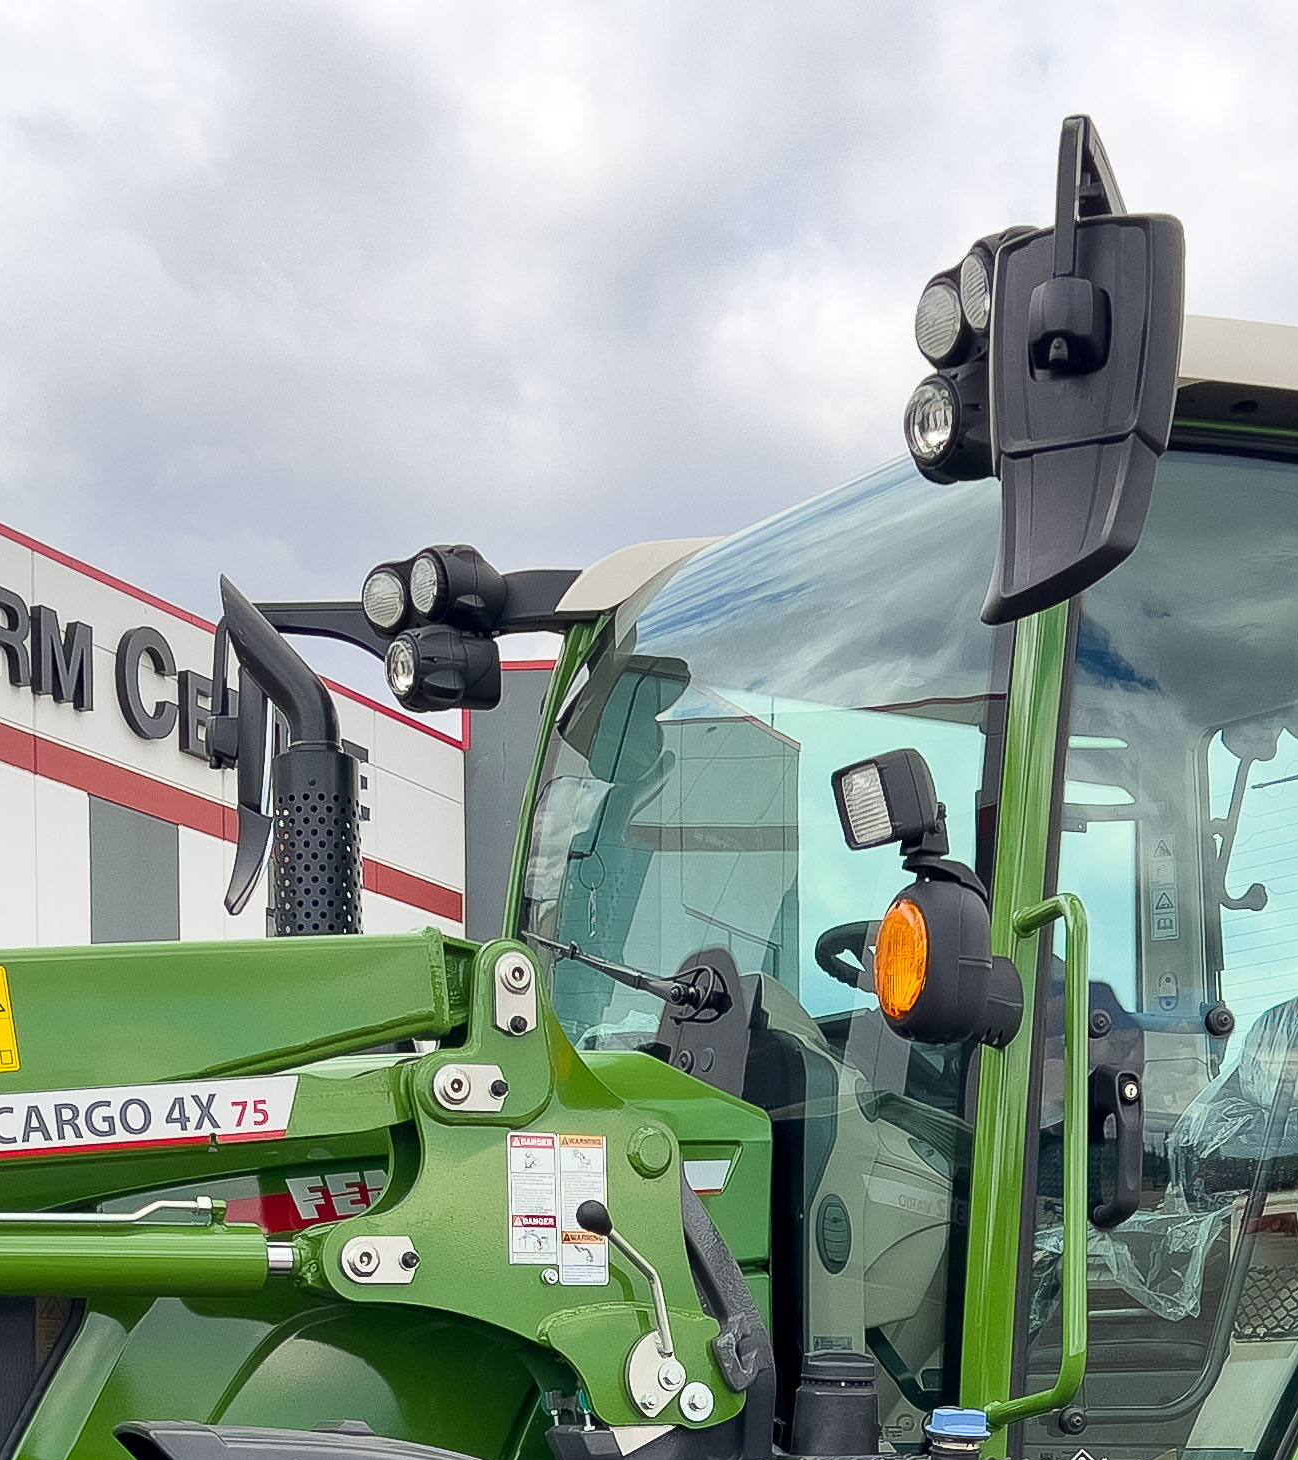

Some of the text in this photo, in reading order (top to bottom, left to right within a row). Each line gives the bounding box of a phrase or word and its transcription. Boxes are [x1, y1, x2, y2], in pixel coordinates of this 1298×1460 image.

[166, 1093, 222, 1132] 4X
[231, 1099, 270, 1128] 75
[520, 1136, 553, 1147] DANGER
[522, 1217, 555, 1226] DANGER
